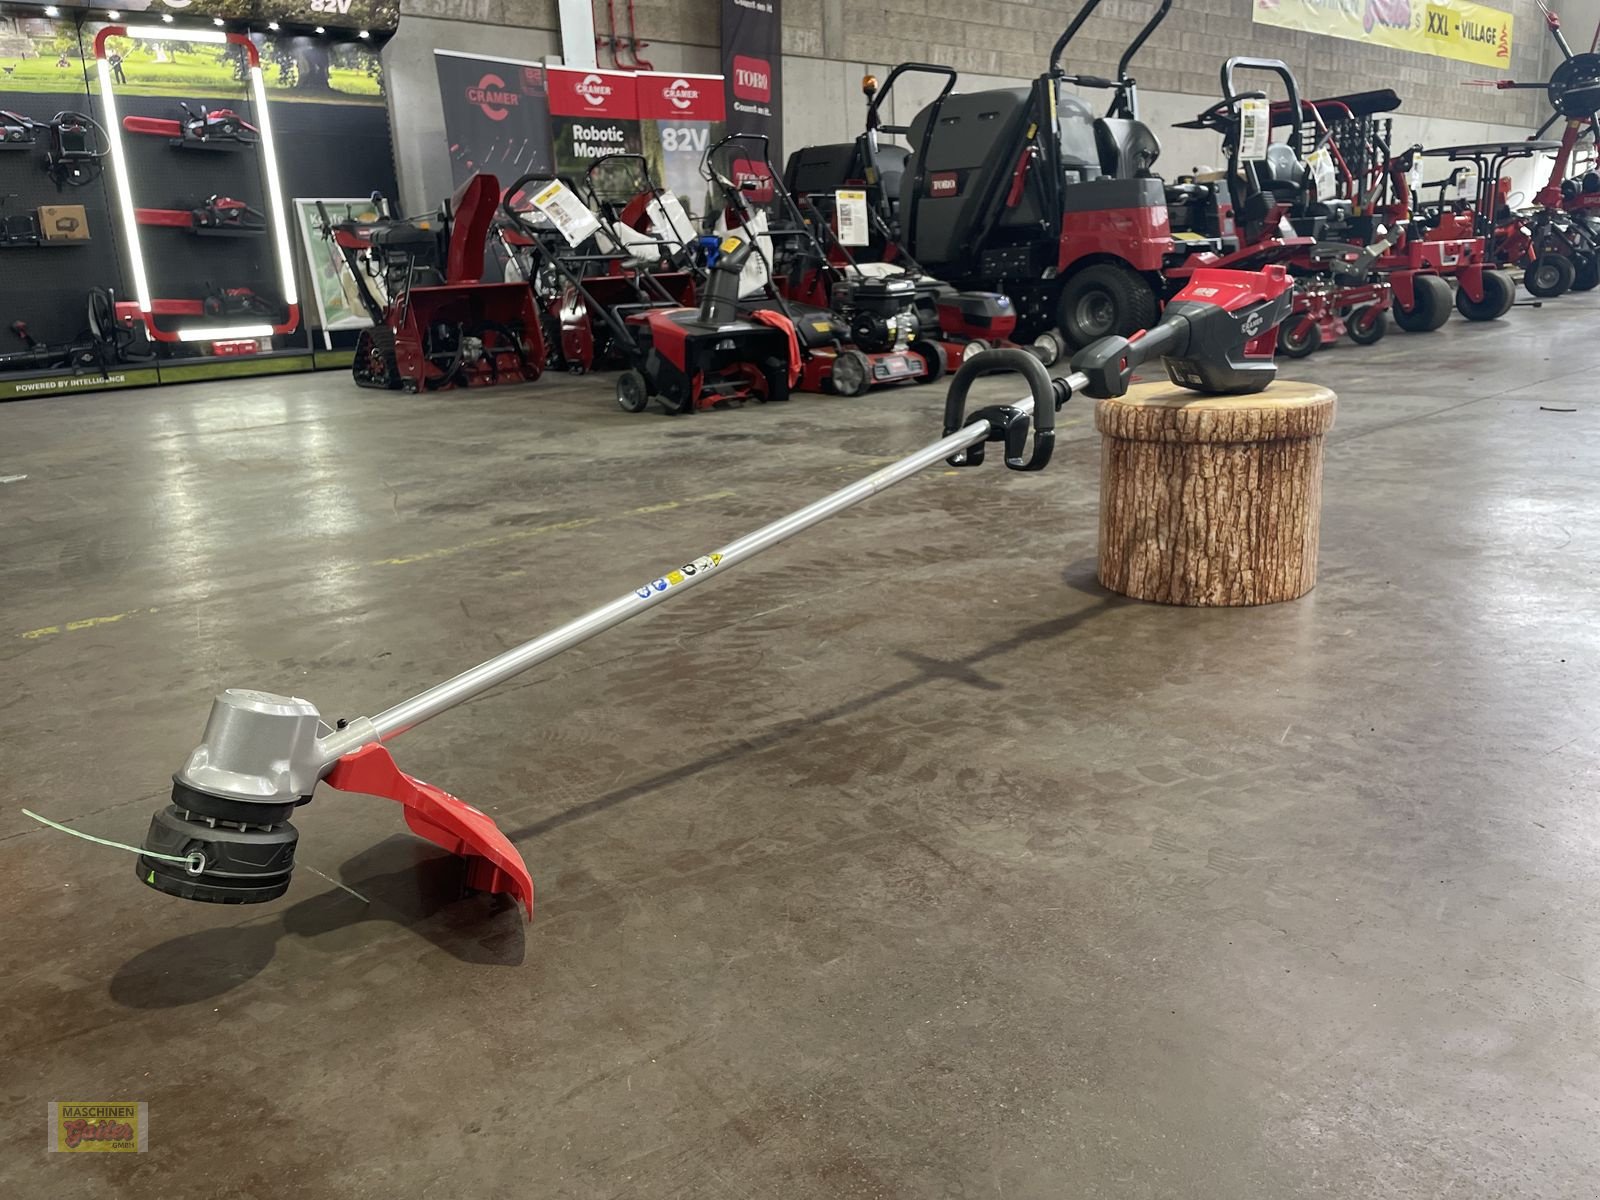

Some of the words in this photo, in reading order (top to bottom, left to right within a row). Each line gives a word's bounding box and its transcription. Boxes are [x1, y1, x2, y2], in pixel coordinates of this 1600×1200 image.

[1428, 11, 1449, 36] XXL
[1461, 20, 1497, 45] VILLAGE
[736, 69, 768, 90] TORO
[468, 88, 520, 106] CRAMER
[575, 83, 612, 96] CRAMER
[663, 88, 699, 99] CRAMER
[573, 124, 624, 142] Robotic
[662, 127, 708, 152] 82V
[932, 180, 956, 190] TORO
[15, 381, 57, 392] POWERED
[58, 379, 69, 388] BY
[70, 375, 125, 387] INTELLIGNCE
